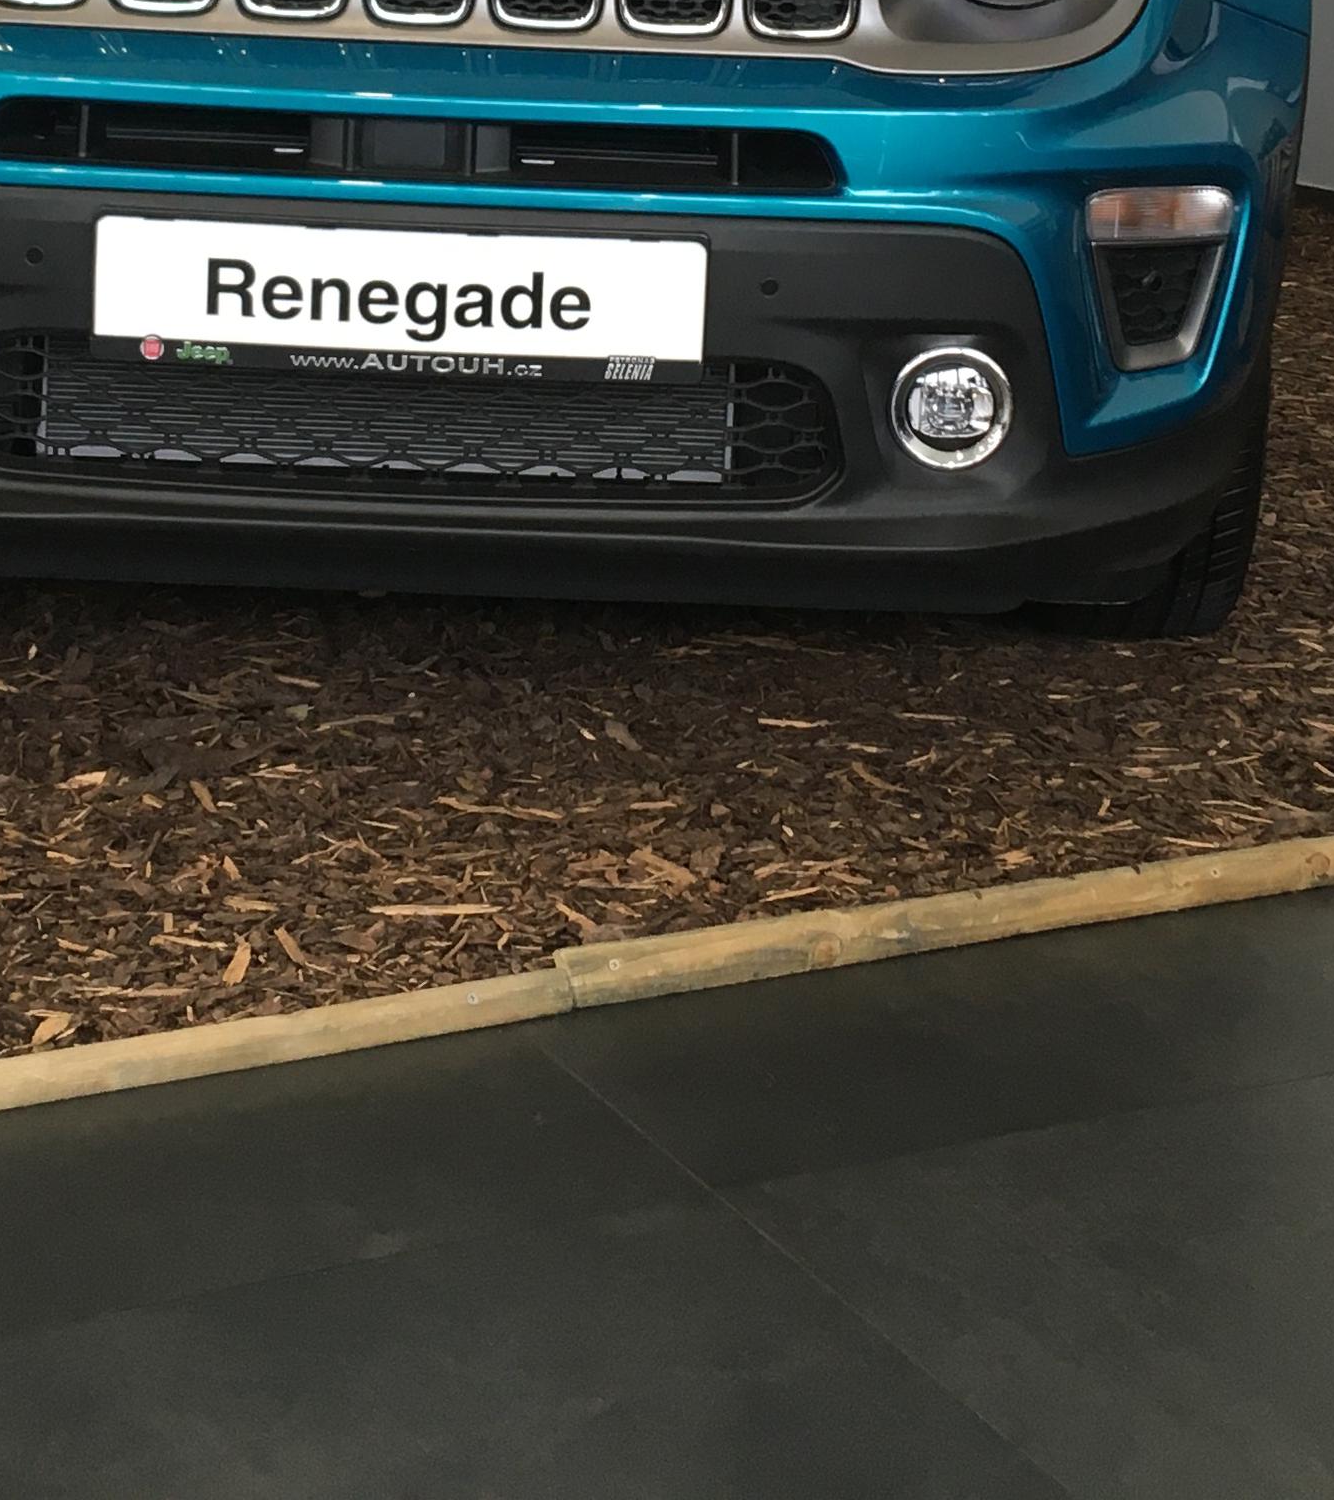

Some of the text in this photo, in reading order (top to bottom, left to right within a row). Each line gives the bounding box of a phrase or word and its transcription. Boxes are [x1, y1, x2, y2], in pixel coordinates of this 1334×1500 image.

[205, 257, 592, 343] Renegade
[175, 340, 231, 365] Jeep
[289, 352, 544, 378] www.AUTOUH.cz
[603, 363, 655, 381] SELENIA
